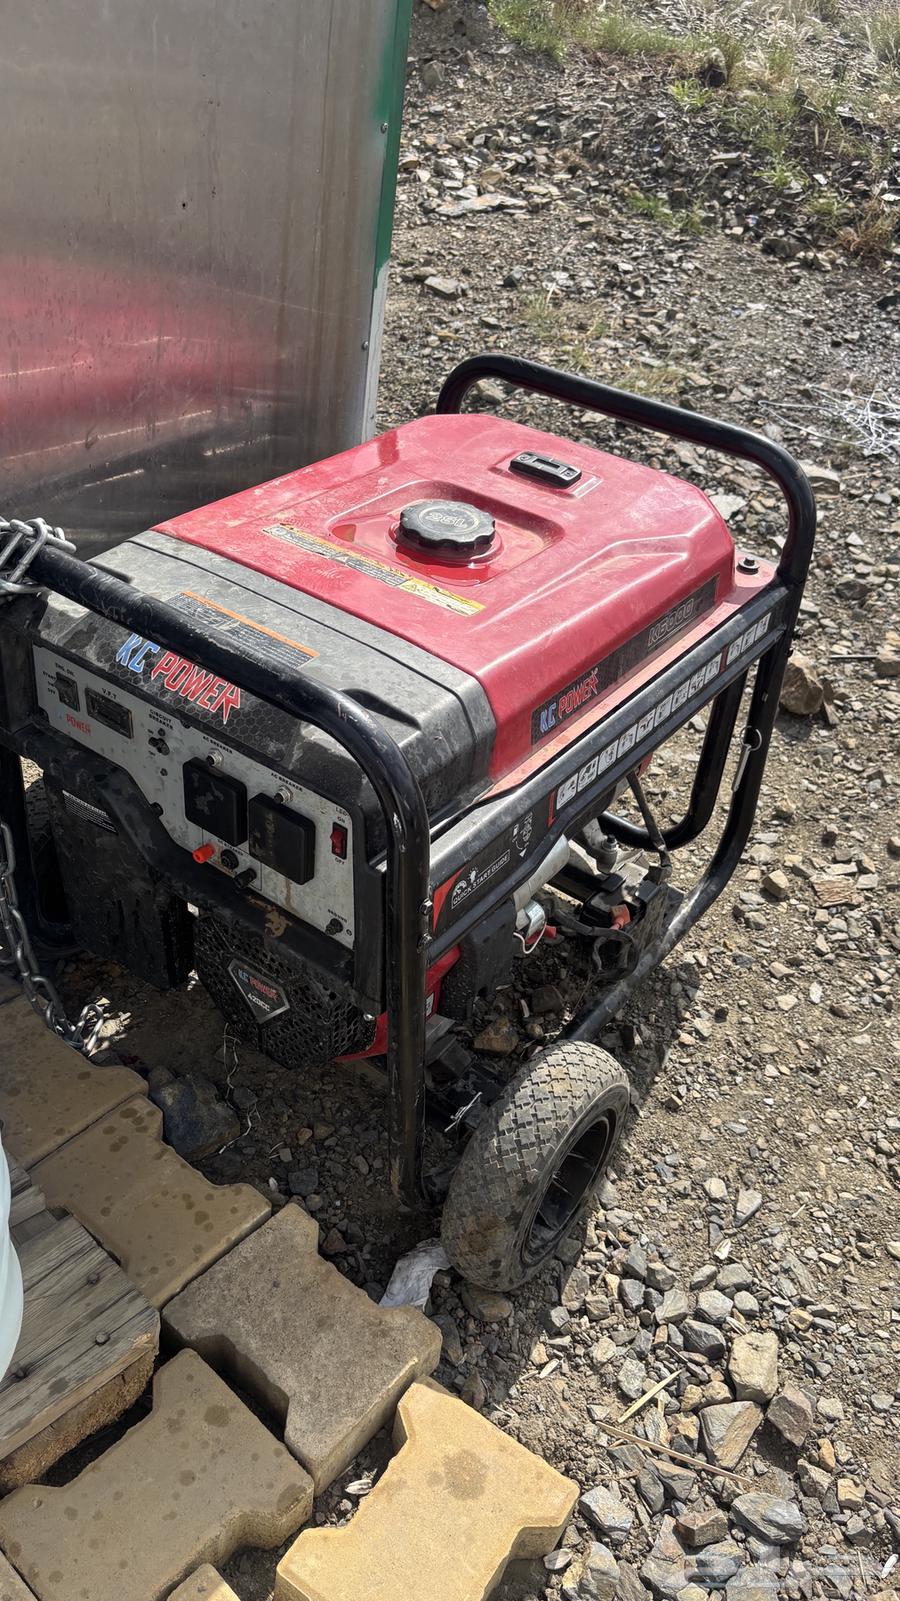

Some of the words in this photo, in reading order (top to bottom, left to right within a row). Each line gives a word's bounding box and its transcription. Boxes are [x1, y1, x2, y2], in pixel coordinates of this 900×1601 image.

[116, 632, 160, 673] KC
[151, 651, 241, 724] POWER
[541, 702, 556, 733] KC
[558, 670, 599, 719] POWER
[453, 887, 472, 905] QUICK
[472, 871, 491, 889] START
[491, 854, 509, 873] GUIDE
